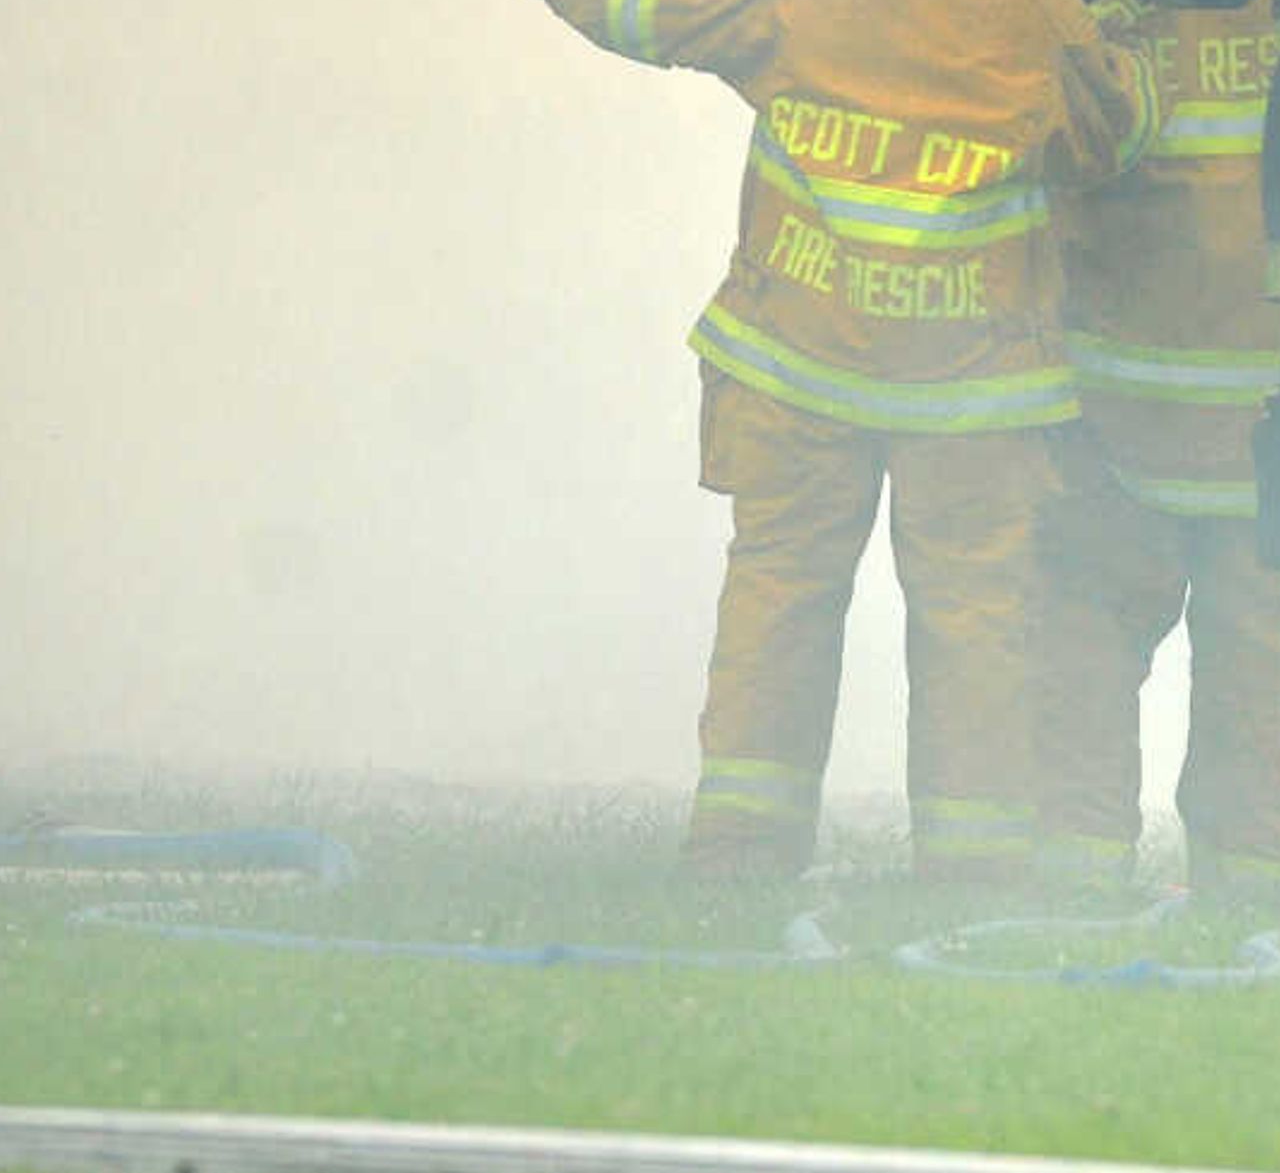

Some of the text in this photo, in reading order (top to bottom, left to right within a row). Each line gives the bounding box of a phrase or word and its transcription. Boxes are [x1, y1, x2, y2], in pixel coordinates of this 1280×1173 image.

[1199, 35, 1280, 94] RES
[771, 96, 904, 174] SCOTT
[767, 214, 837, 294] FIRE
